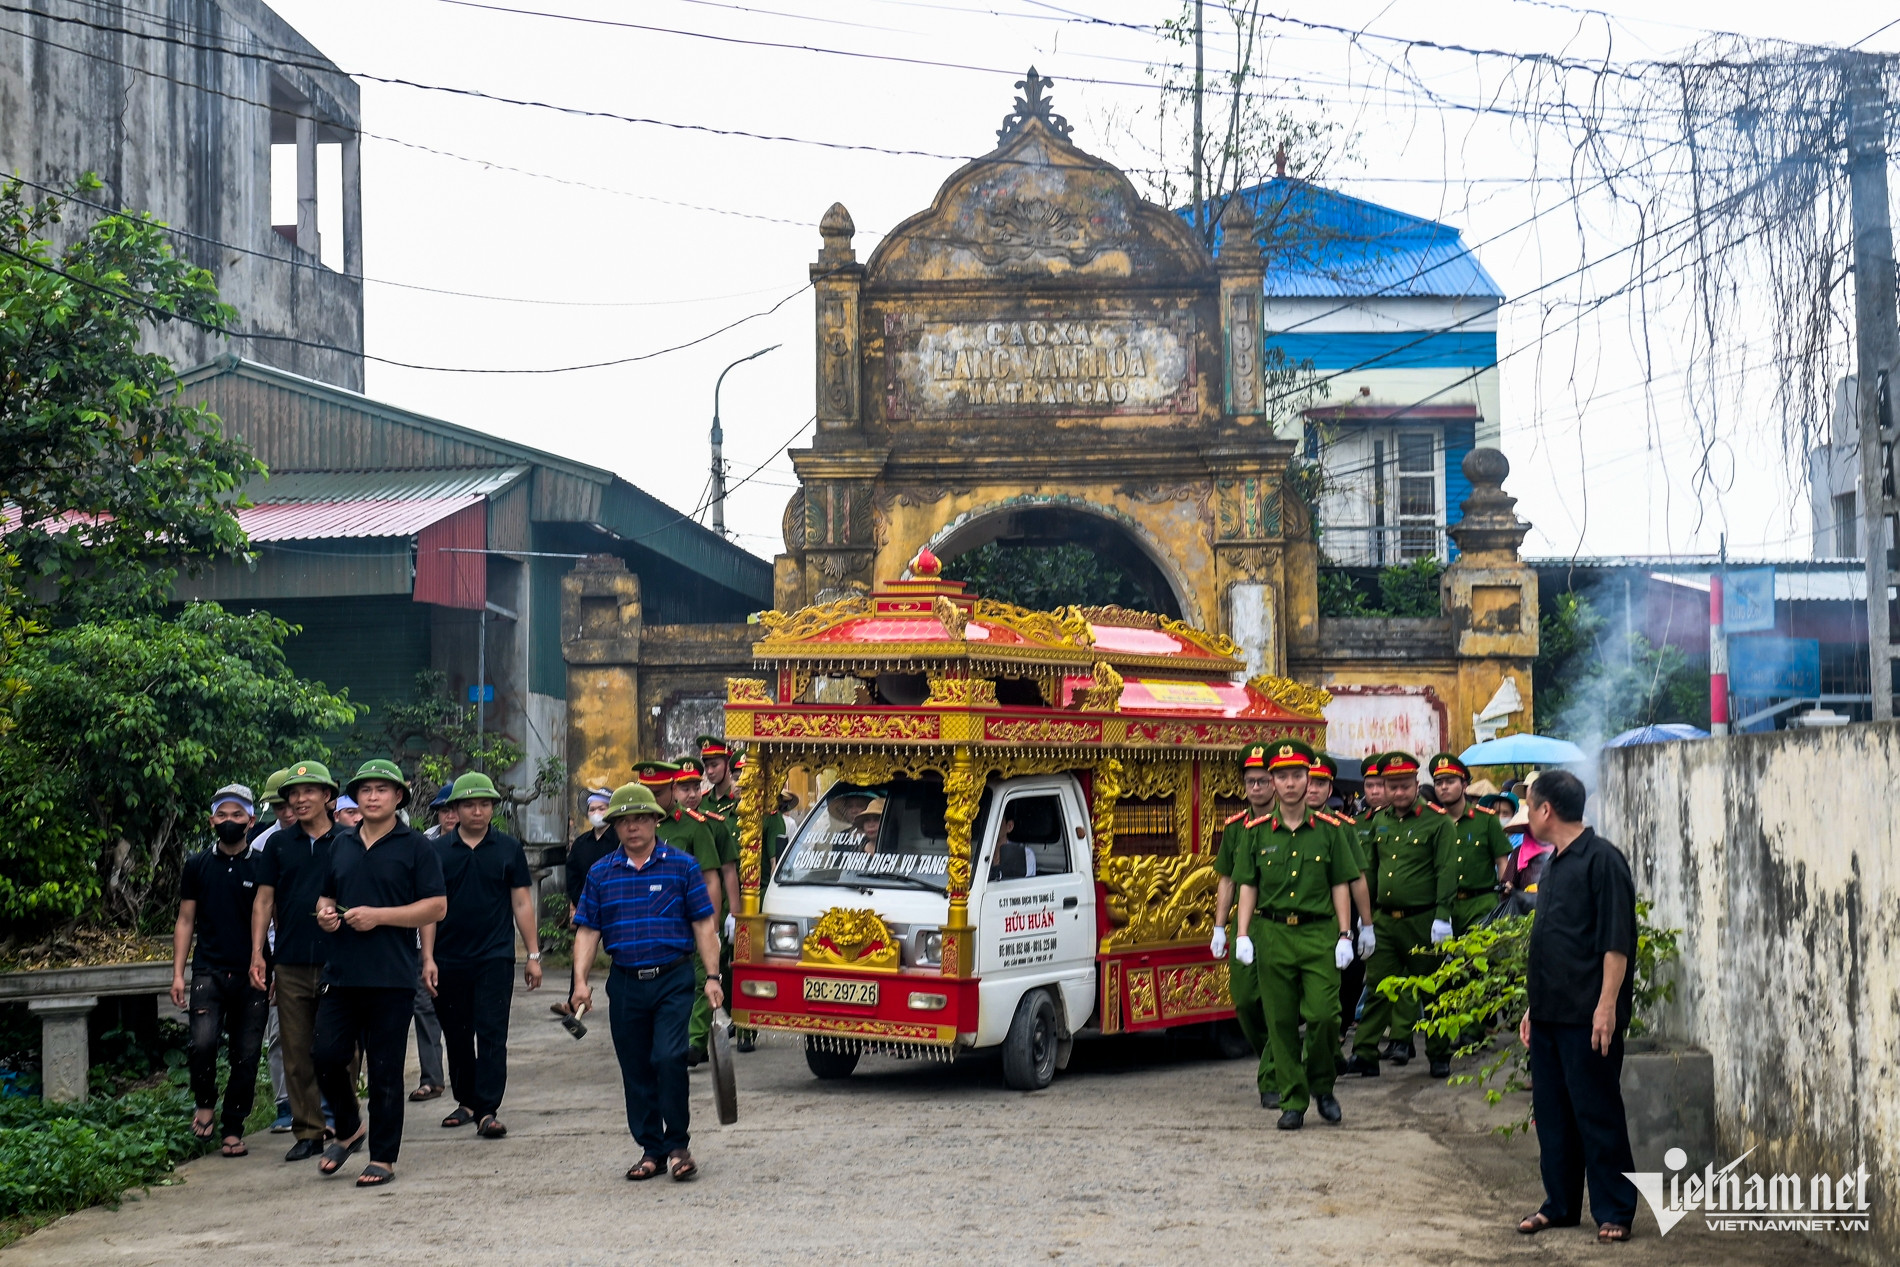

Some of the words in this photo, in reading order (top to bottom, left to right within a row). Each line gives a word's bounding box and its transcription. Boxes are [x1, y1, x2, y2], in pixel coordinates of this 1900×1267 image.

[793, 848, 825, 869] CÔNG
[823, 850, 841, 869] TY
[838, 851, 873, 870] TNHH
[867, 853, 900, 874] DỊCH
[899, 854, 918, 876] VỤ
[917, 855, 949, 875] TANG
[1005, 910, 1026, 933] HỮU
[1028, 905, 1055, 930] HUẤN
